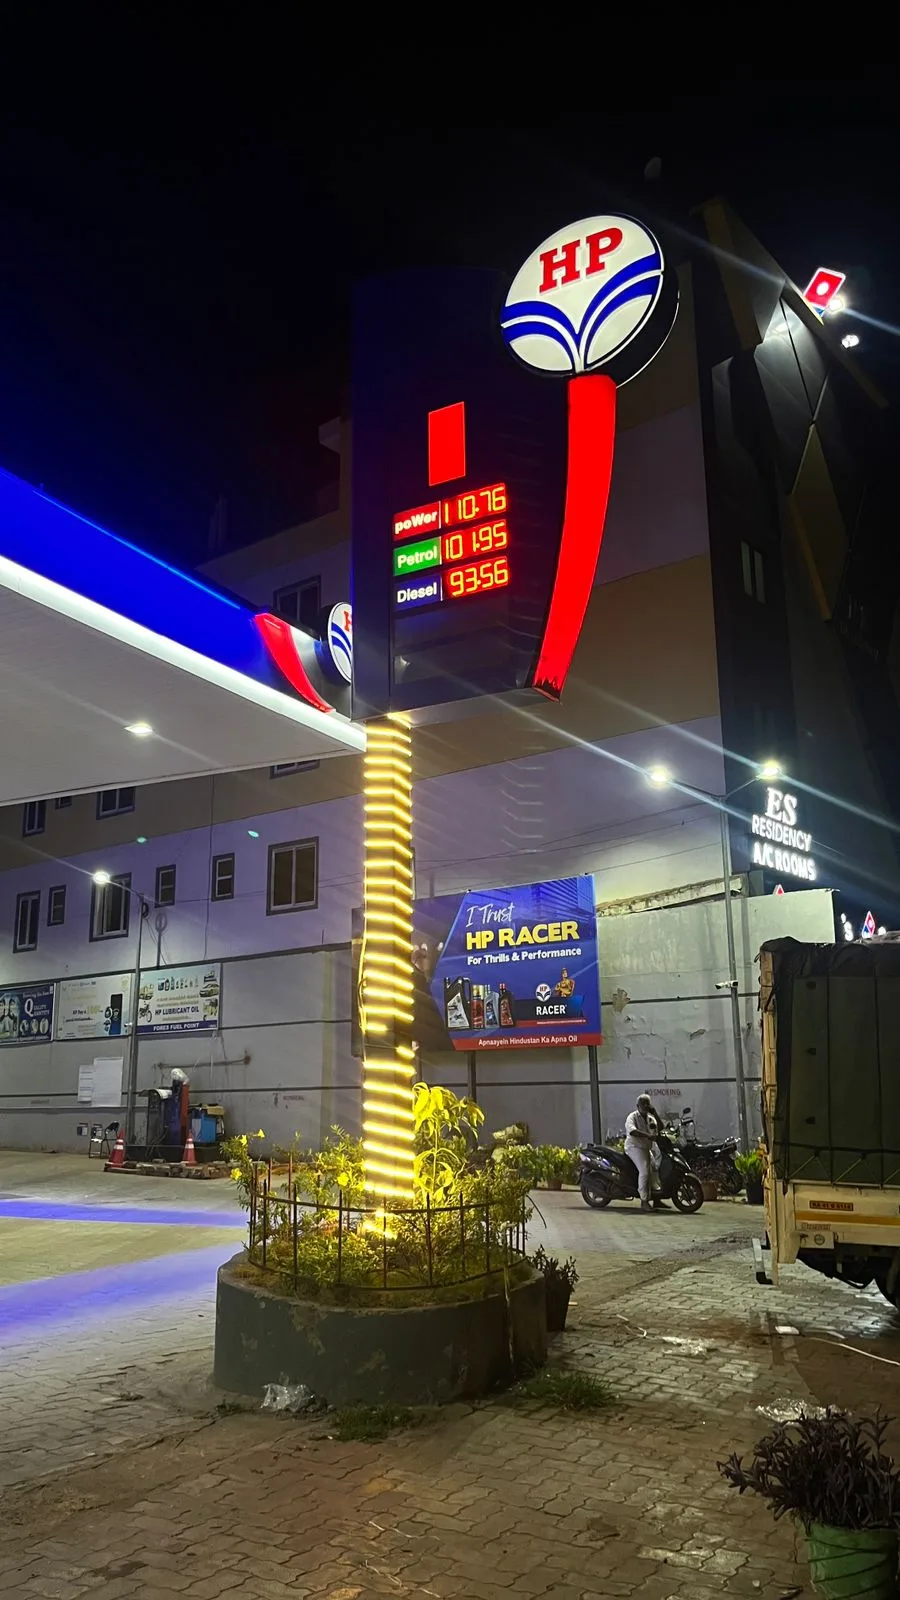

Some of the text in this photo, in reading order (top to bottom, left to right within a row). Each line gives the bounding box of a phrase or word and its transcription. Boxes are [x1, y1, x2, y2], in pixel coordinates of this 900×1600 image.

[539, 227, 623, 293] HP
[397, 522, 508, 569] Petrol 101.95
[396, 559, 509, 604] Diesel 93.56
[764, 786, 798, 826] ES
[752, 814, 812, 852] RESIDENCY
[774, 849, 817, 882] ROOMS
[466, 901, 515, 928] I Trust
[466, 920, 581, 951] HP RACER
[467, 947, 582, 966] For Thrills & Performance
[539, 985, 549, 993] HP
[162, 1006, 191, 1016] LUBRICANT
[190, 1005, 200, 1014] OIL
[536, 1005, 567, 1016] RACER
[169, 1023, 183, 1031] FUEL
[183, 1022, 200, 1030] POINT
[478, 1034, 578, 1047] Apnaayein Hindustan Ka Apna Oil
[653, 1088, 681, 1097] SMOKING
